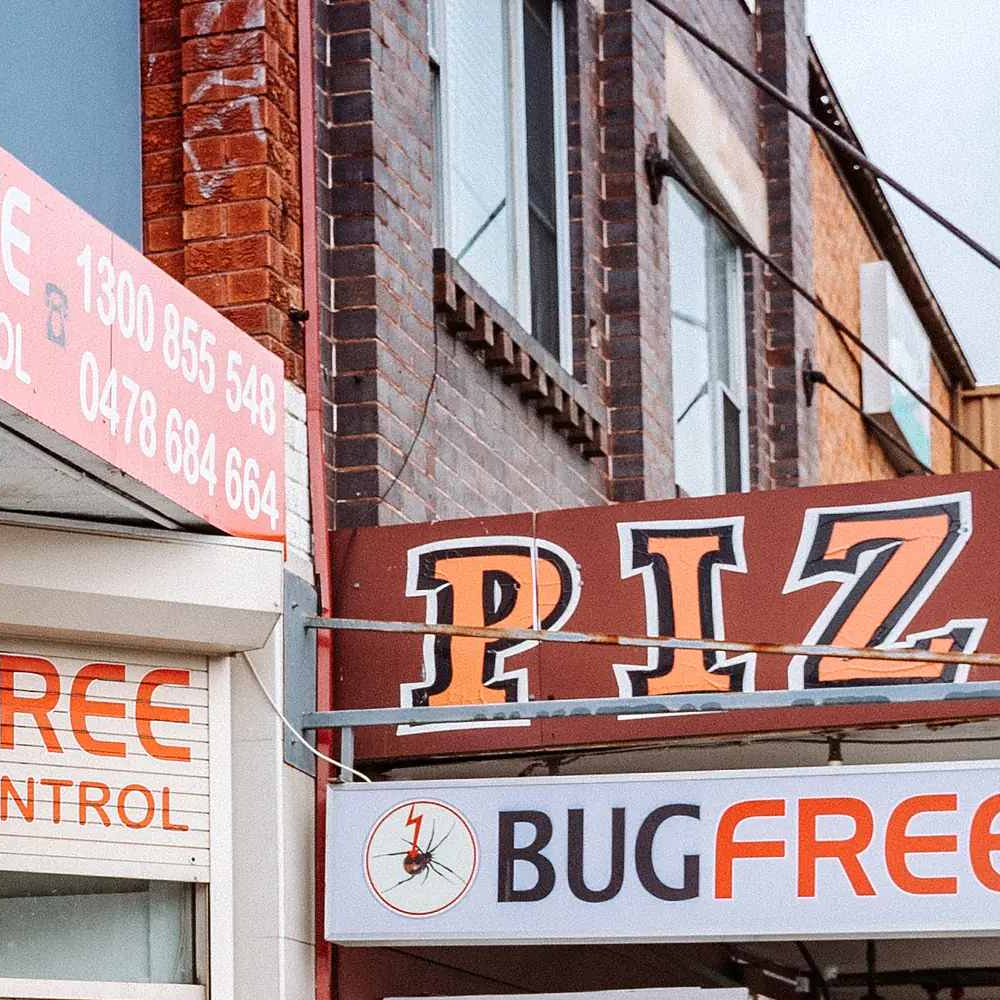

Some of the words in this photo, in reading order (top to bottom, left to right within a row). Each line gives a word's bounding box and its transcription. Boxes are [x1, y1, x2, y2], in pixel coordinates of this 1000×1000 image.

[76, 243, 154, 352] 1300
[162, 302, 217, 395] 855
[226, 349, 277, 436] 548
[79, 352, 157, 458] 0478
[165, 407, 218, 497] 684
[225, 447, 279, 531] 664
